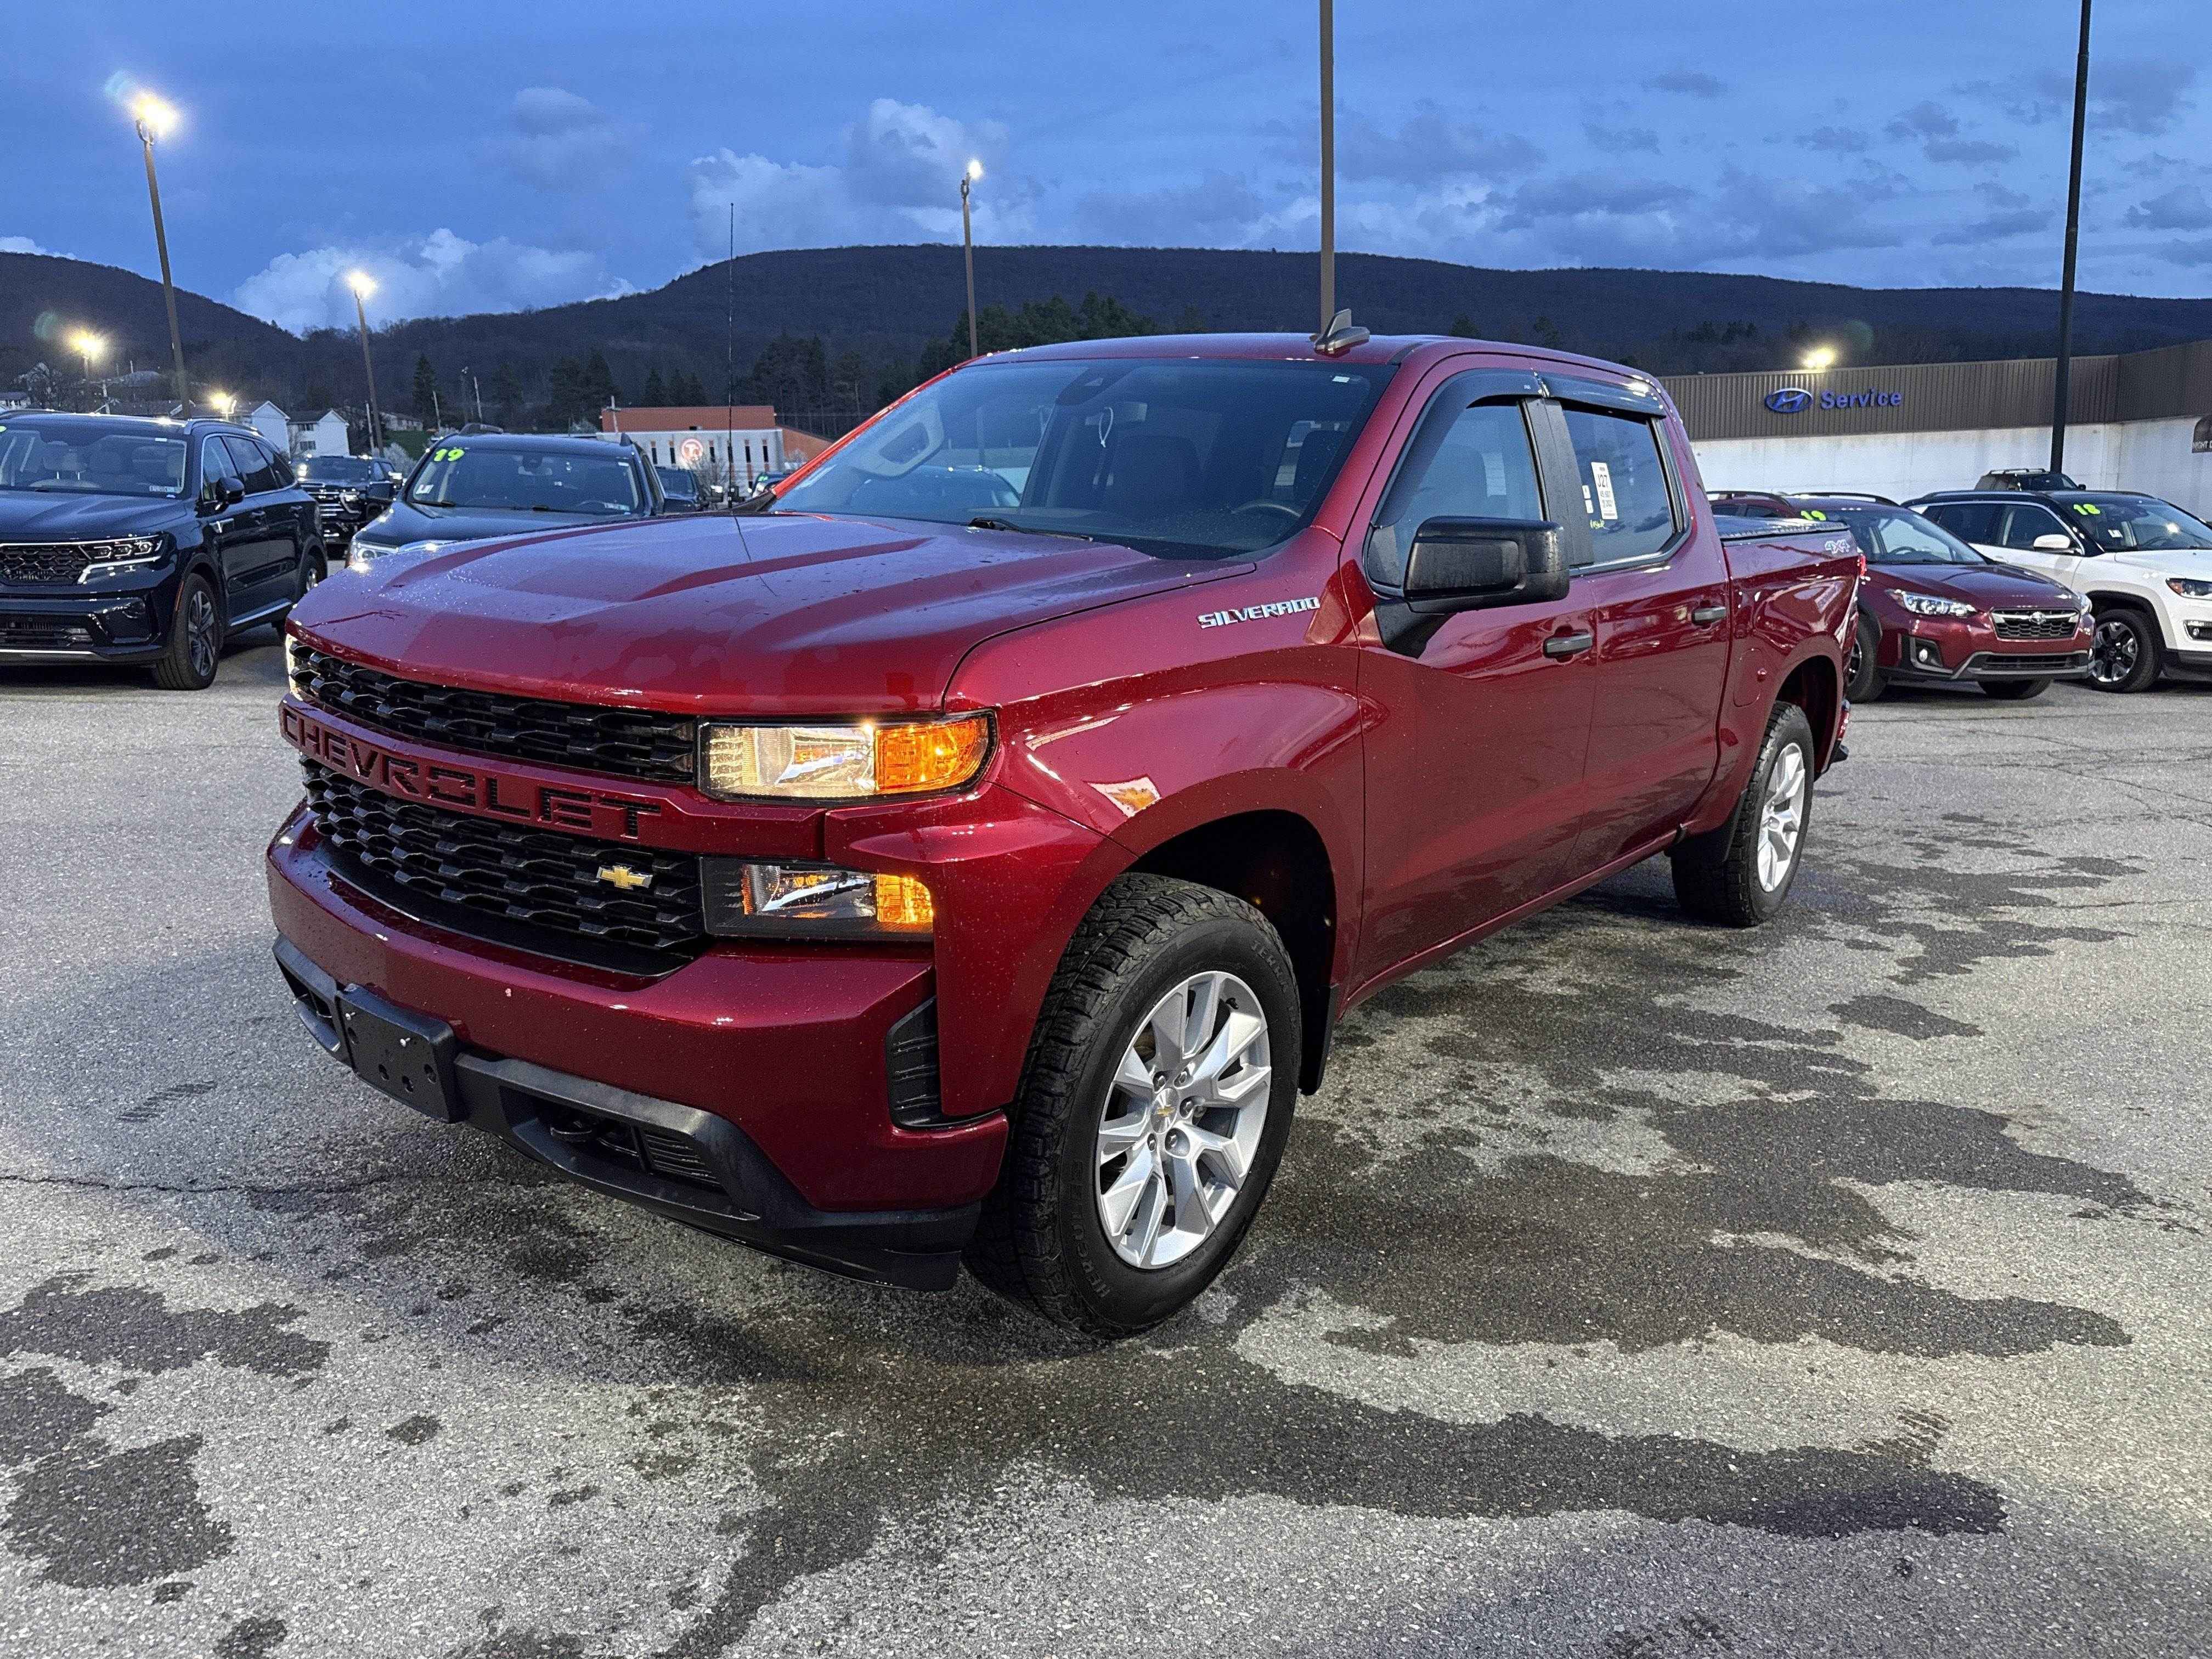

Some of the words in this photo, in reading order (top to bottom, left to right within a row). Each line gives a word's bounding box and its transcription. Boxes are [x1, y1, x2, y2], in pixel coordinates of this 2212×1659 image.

[1821, 387, 1902, 409] Service
[434, 449, 465, 461] 19
[1598, 473, 1608, 488] J27
[2074, 504, 2101, 515] 18
[1197, 596, 1321, 629] SILVERADO
[282, 708, 662, 839] CHEVROLET
[1069, 1160, 1111, 1299] HERCULES
